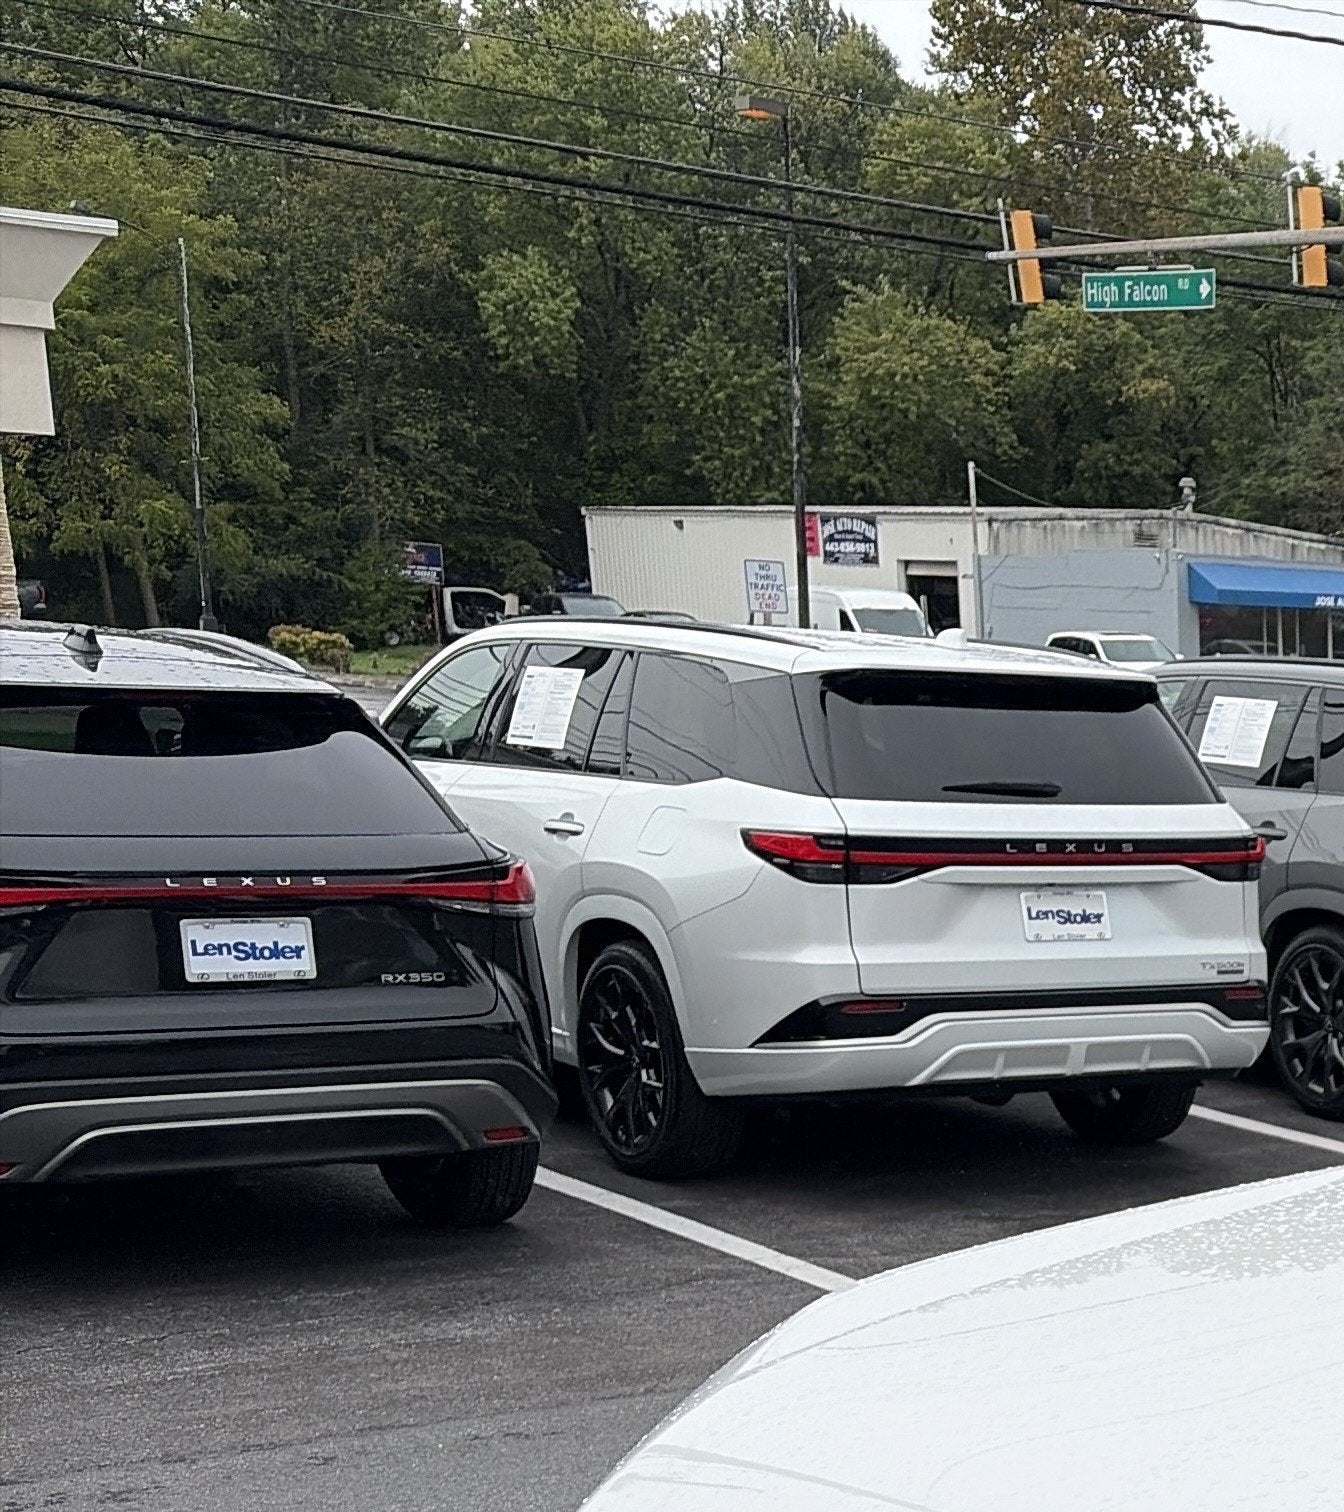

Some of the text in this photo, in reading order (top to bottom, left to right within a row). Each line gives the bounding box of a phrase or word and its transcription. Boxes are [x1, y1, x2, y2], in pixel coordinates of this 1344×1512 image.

[1087, 281, 1119, 308] High
[1124, 280, 1168, 301] Falcon
[758, 563, 771, 572] NO
[755, 572, 777, 581] THRU
[750, 582, 785, 592] TRAFFIC
[755, 592, 780, 602] DEAD
[760, 601, 777, 610] END
[1006, 842, 1134, 853] LEXUS
[166, 876, 328, 888] LEXUS
[225, 970, 278, 981] Len Stoler
[381, 972, 446, 984] RX350
